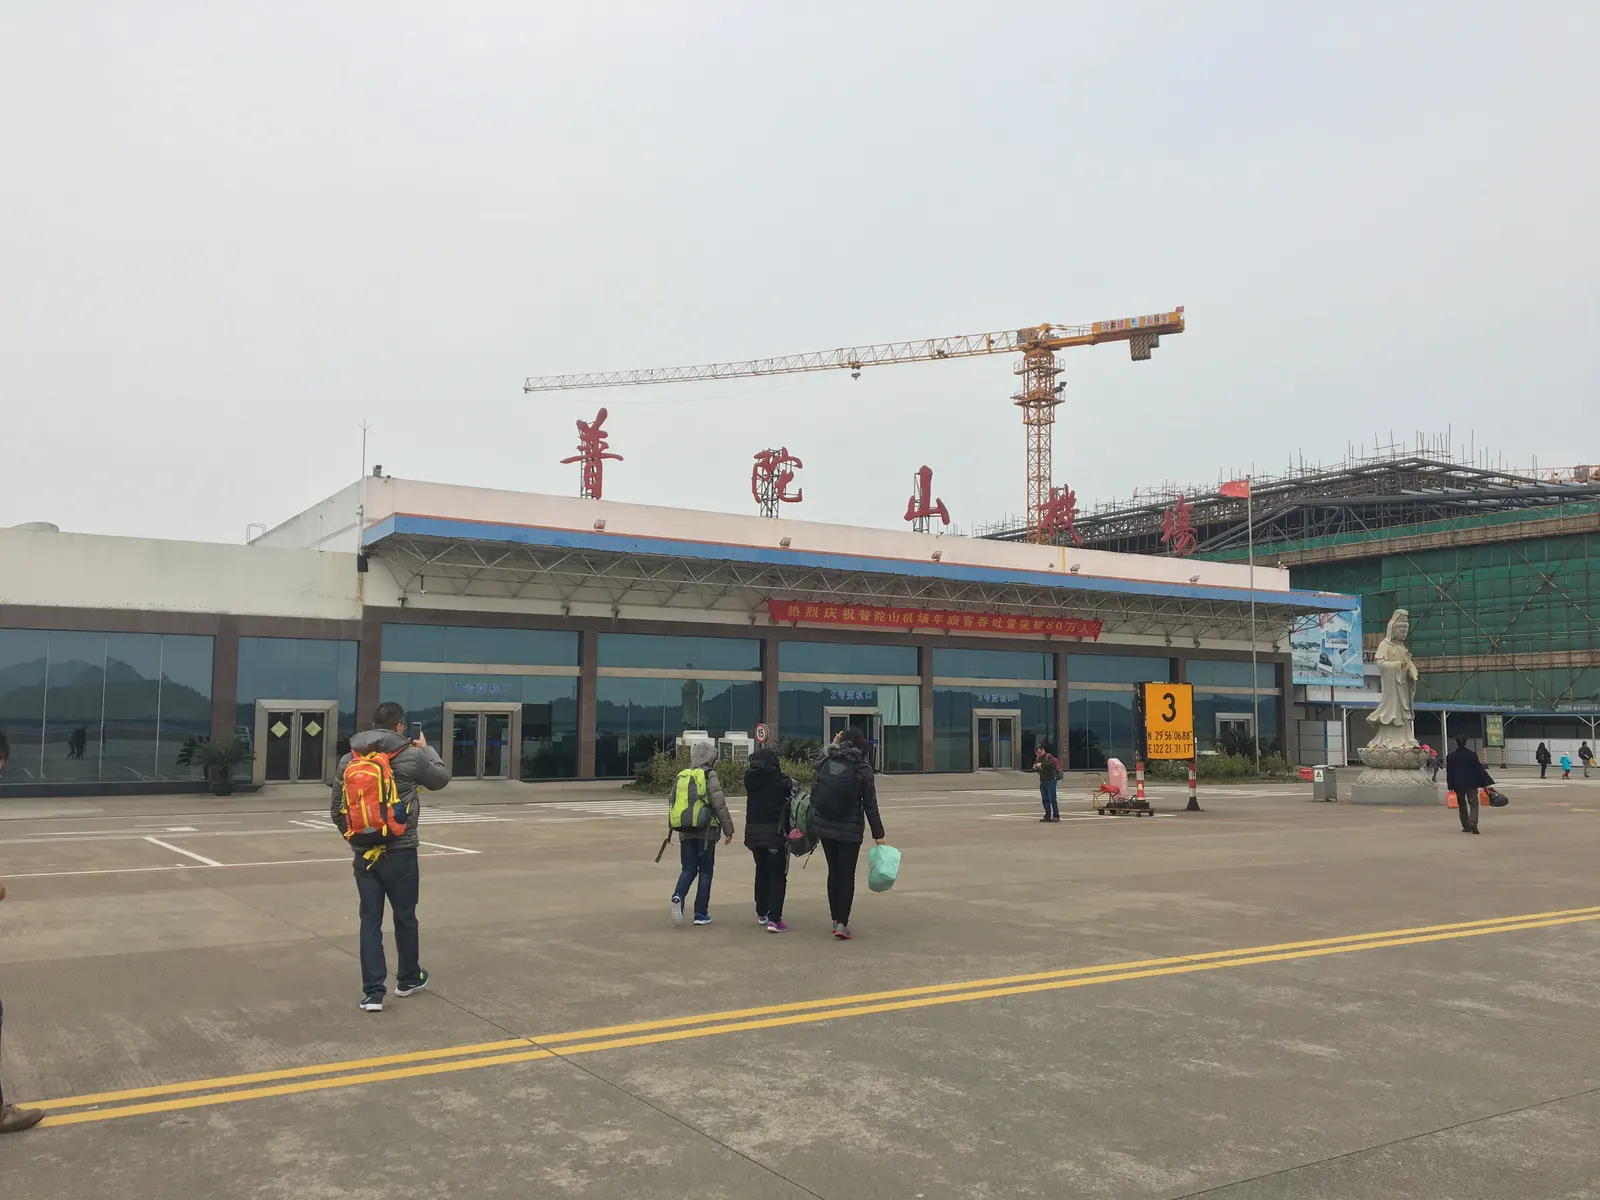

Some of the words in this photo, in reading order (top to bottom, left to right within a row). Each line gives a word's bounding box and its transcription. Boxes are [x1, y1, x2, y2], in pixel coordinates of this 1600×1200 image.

[1161, 692, 1177, 722] 3
[757, 728, 764, 738] 15
[1147, 731, 1152, 741] N
